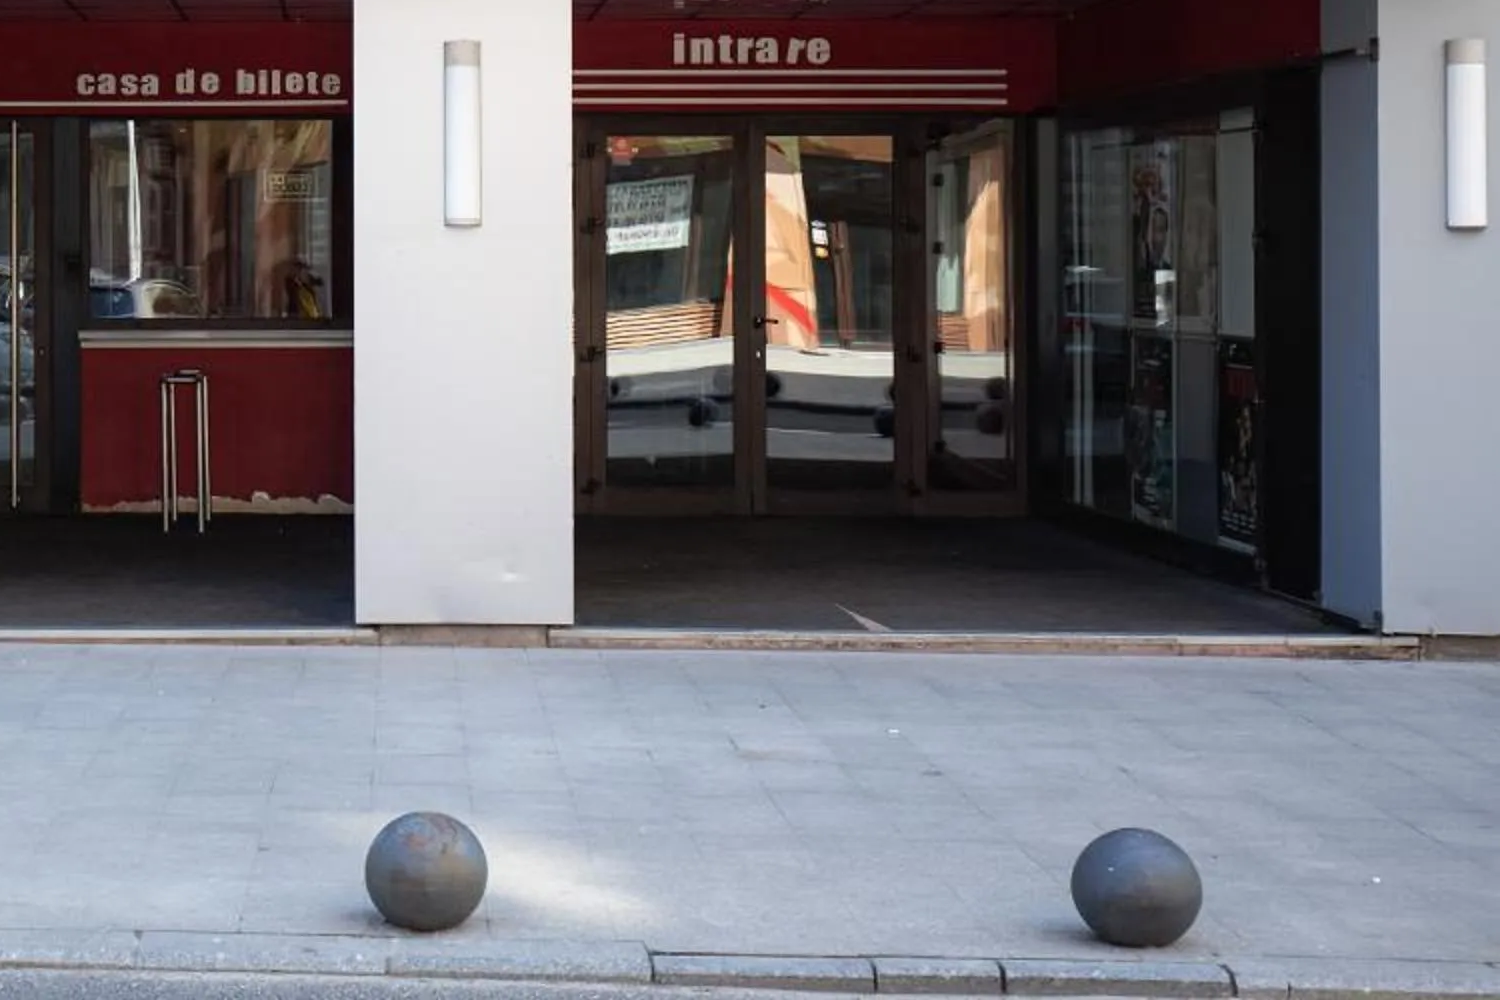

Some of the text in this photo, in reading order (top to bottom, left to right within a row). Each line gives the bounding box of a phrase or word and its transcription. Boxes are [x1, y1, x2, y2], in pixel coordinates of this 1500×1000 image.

[672, 32, 832, 66] intrare
[76, 68, 342, 96] casa de bilete
